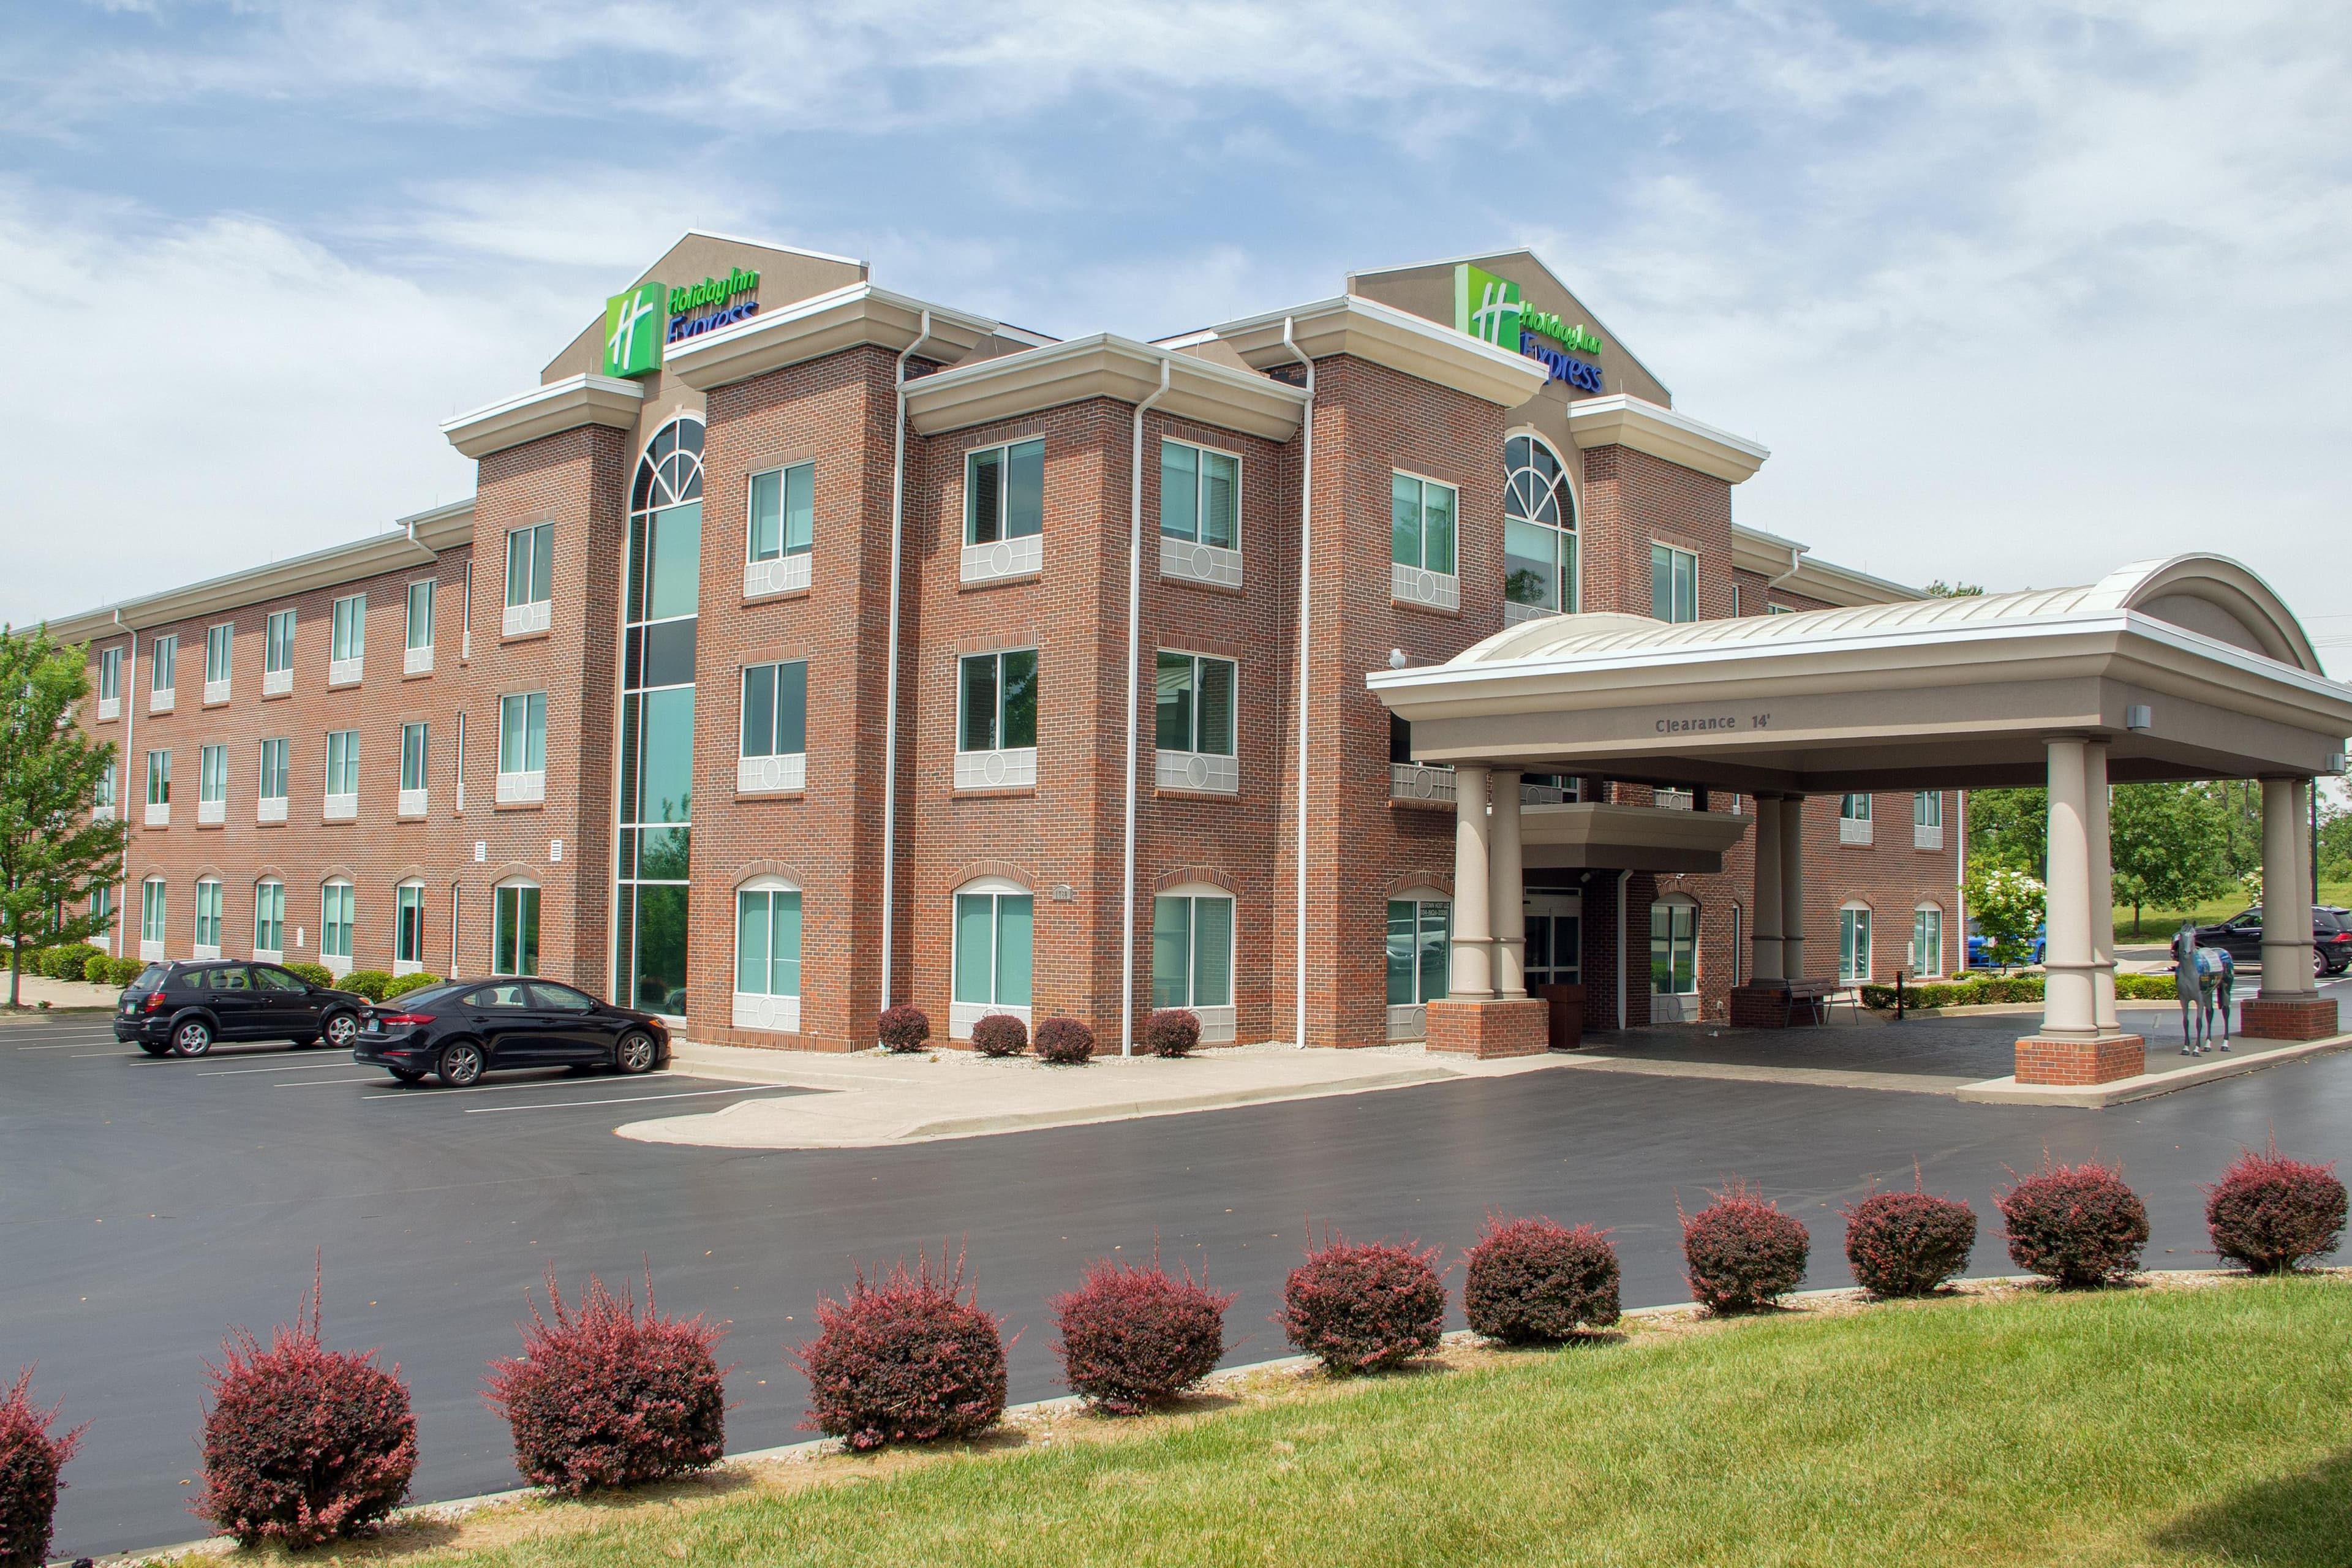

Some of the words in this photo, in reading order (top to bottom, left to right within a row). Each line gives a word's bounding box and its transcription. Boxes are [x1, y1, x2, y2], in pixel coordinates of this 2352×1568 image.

[668, 277, 730, 315] Holiday
[728, 267, 760, 295] Inn
[1519, 300, 1579, 352] Holiday
[1576, 324, 1603, 355] Inn
[1655, 716, 1736, 733] Clearance
